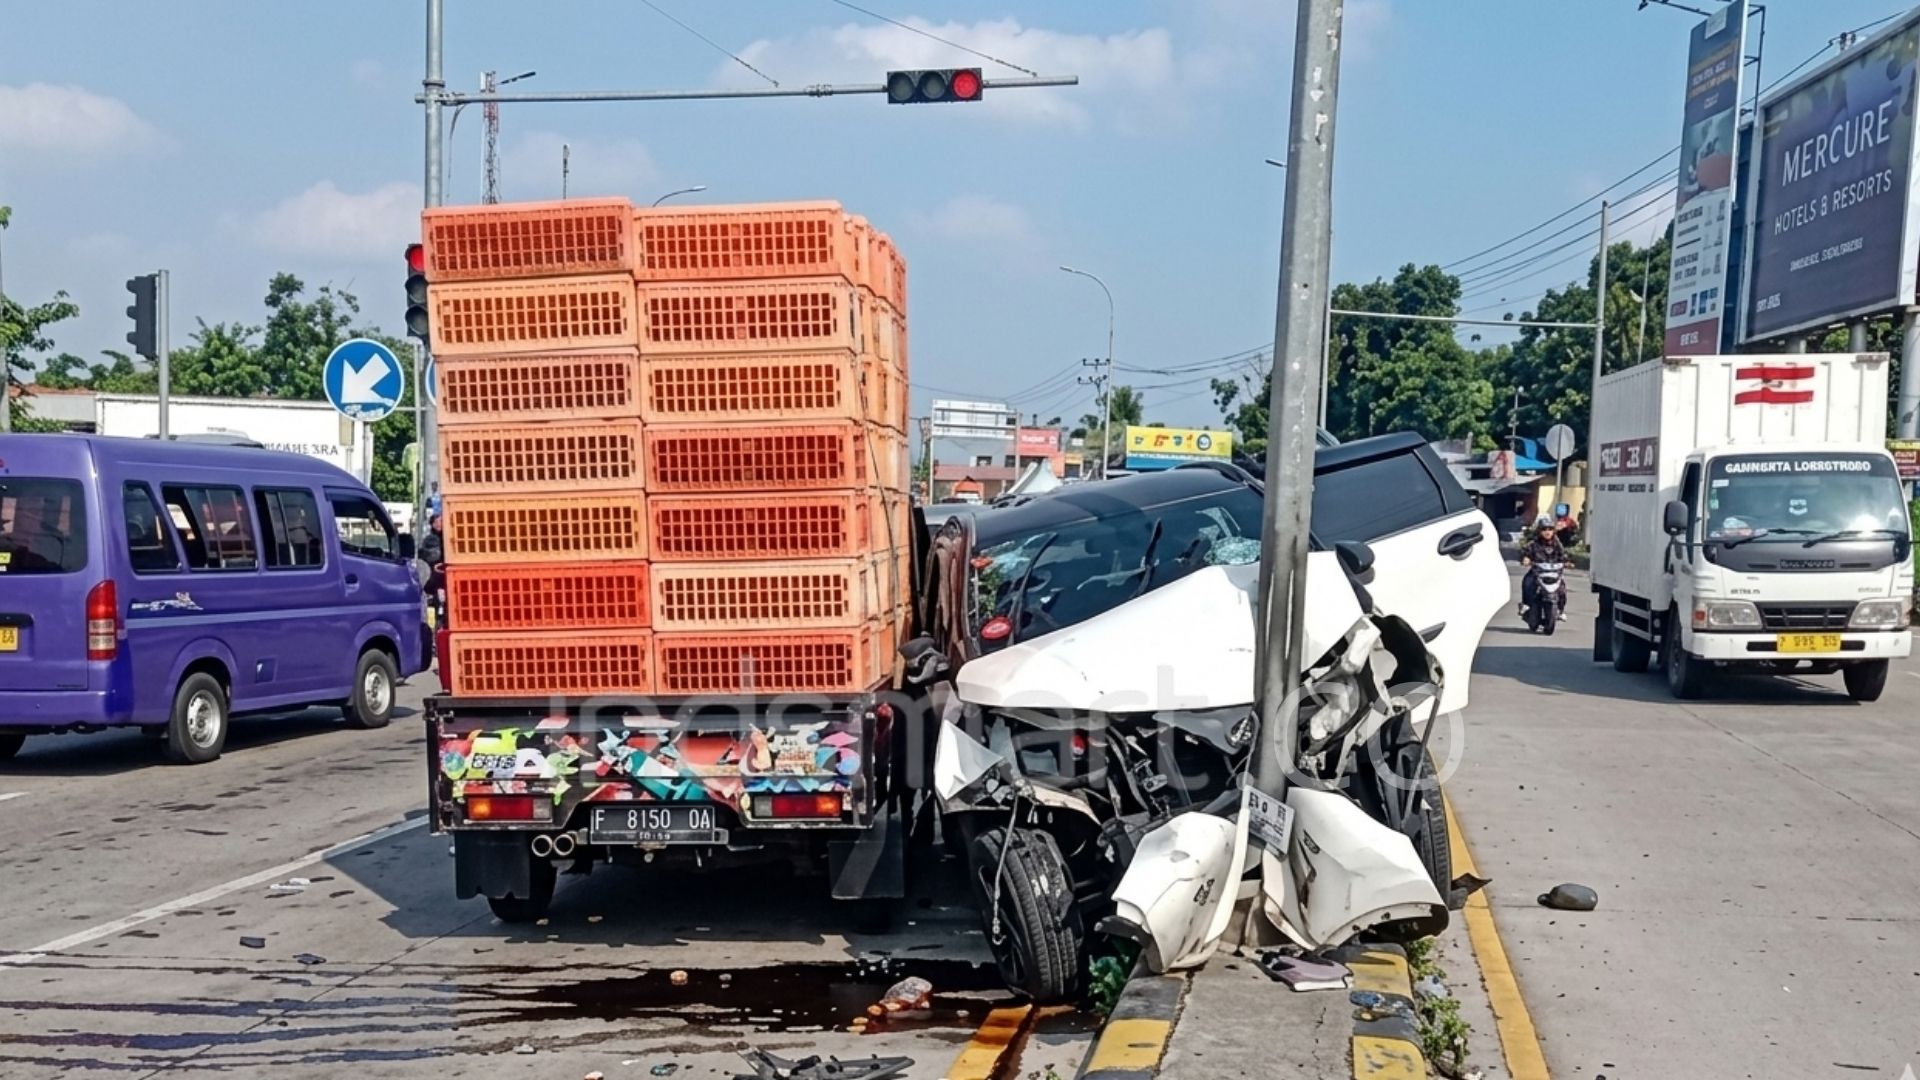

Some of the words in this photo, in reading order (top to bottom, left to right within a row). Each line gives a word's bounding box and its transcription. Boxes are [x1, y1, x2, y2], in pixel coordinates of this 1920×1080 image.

[1782, 100, 1893, 187] MERCURE
[1774, 199, 1818, 236] HOTELS
[1832, 168, 1893, 213] RESORTS
[595, 809, 606, 831] F
[627, 809, 671, 829] 8150
